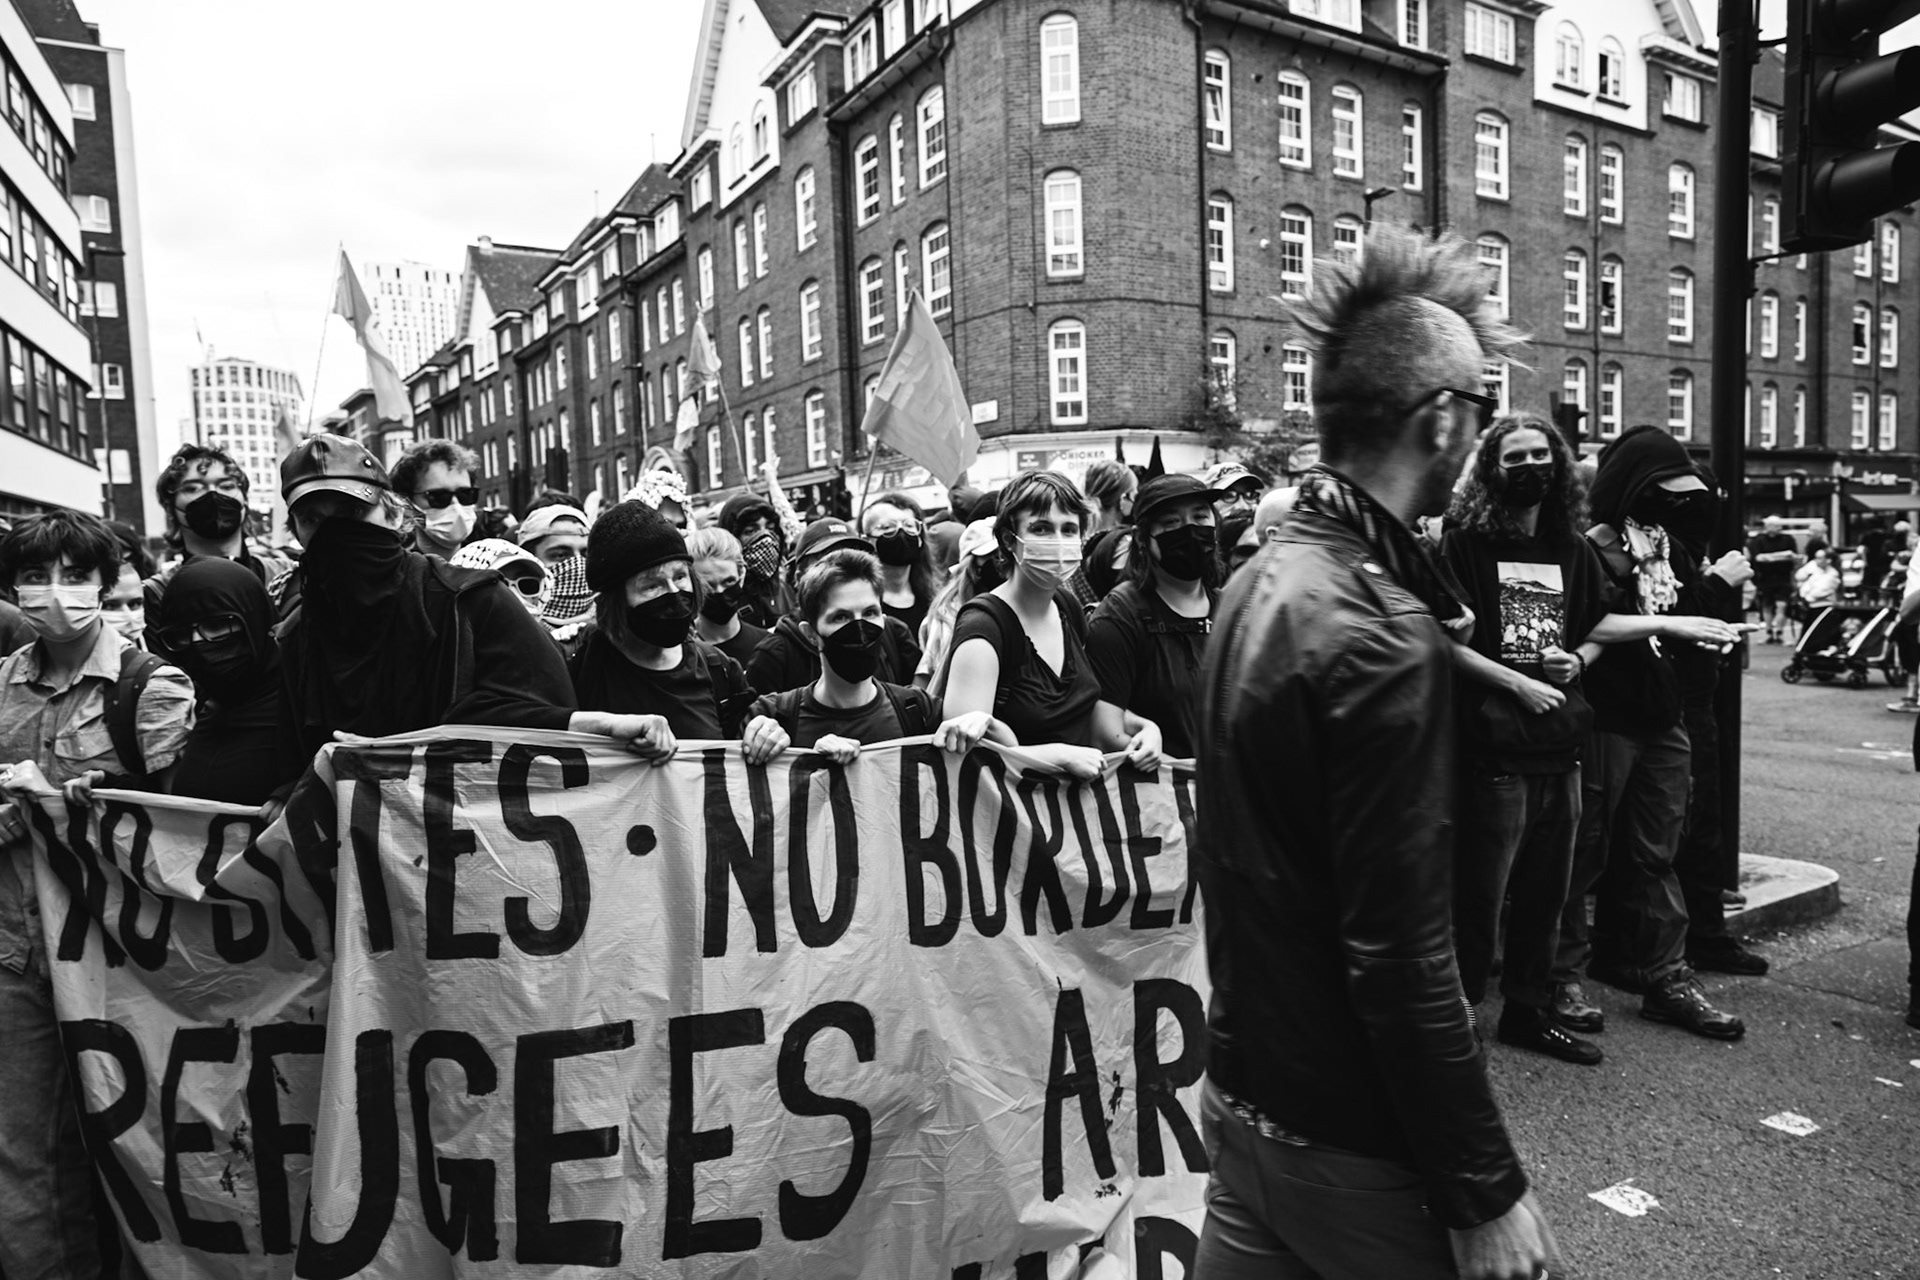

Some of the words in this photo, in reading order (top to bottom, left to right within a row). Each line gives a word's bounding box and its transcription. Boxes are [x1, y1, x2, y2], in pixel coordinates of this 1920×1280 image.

[29, 799, 174, 972] NO
[702, 748, 859, 958] NO
[60, 1001, 876, 1280] REFUGEES
[1042, 977, 1211, 1201] AR
